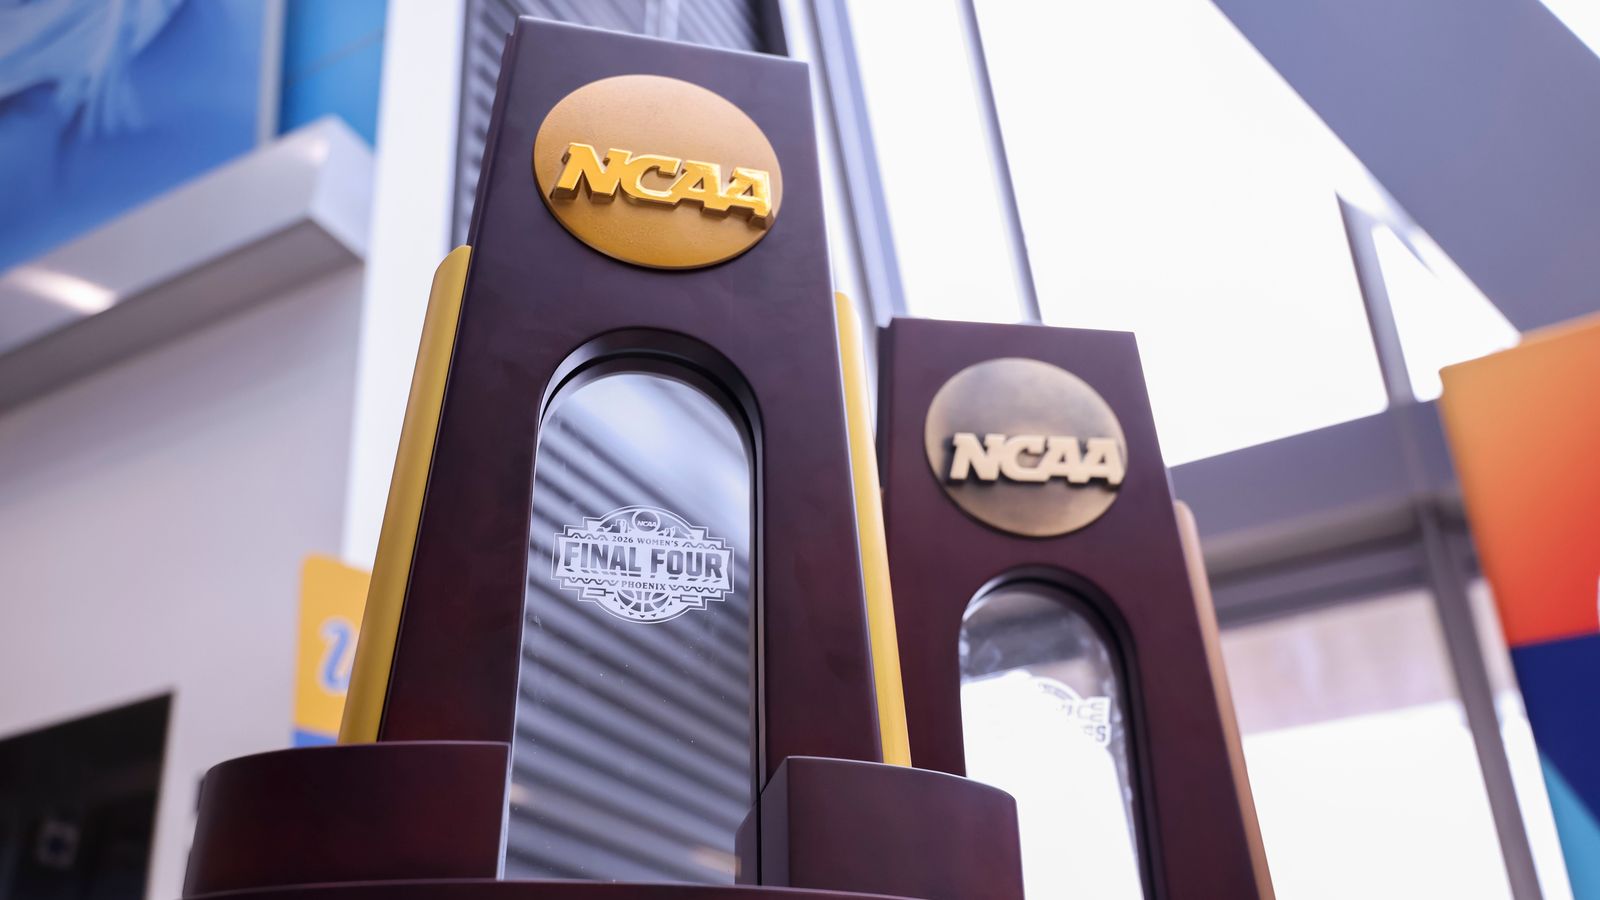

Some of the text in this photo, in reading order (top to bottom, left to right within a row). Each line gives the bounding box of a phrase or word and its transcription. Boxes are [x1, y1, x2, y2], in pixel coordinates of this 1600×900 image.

[553, 142, 773, 226] NCAA
[950, 432, 1125, 485] NCAA
[612, 536, 679, 547] 2026 WOMEN'S
[563, 542, 723, 578] FINAL FOUR
[621, 581, 666, 591] PHOENIX
